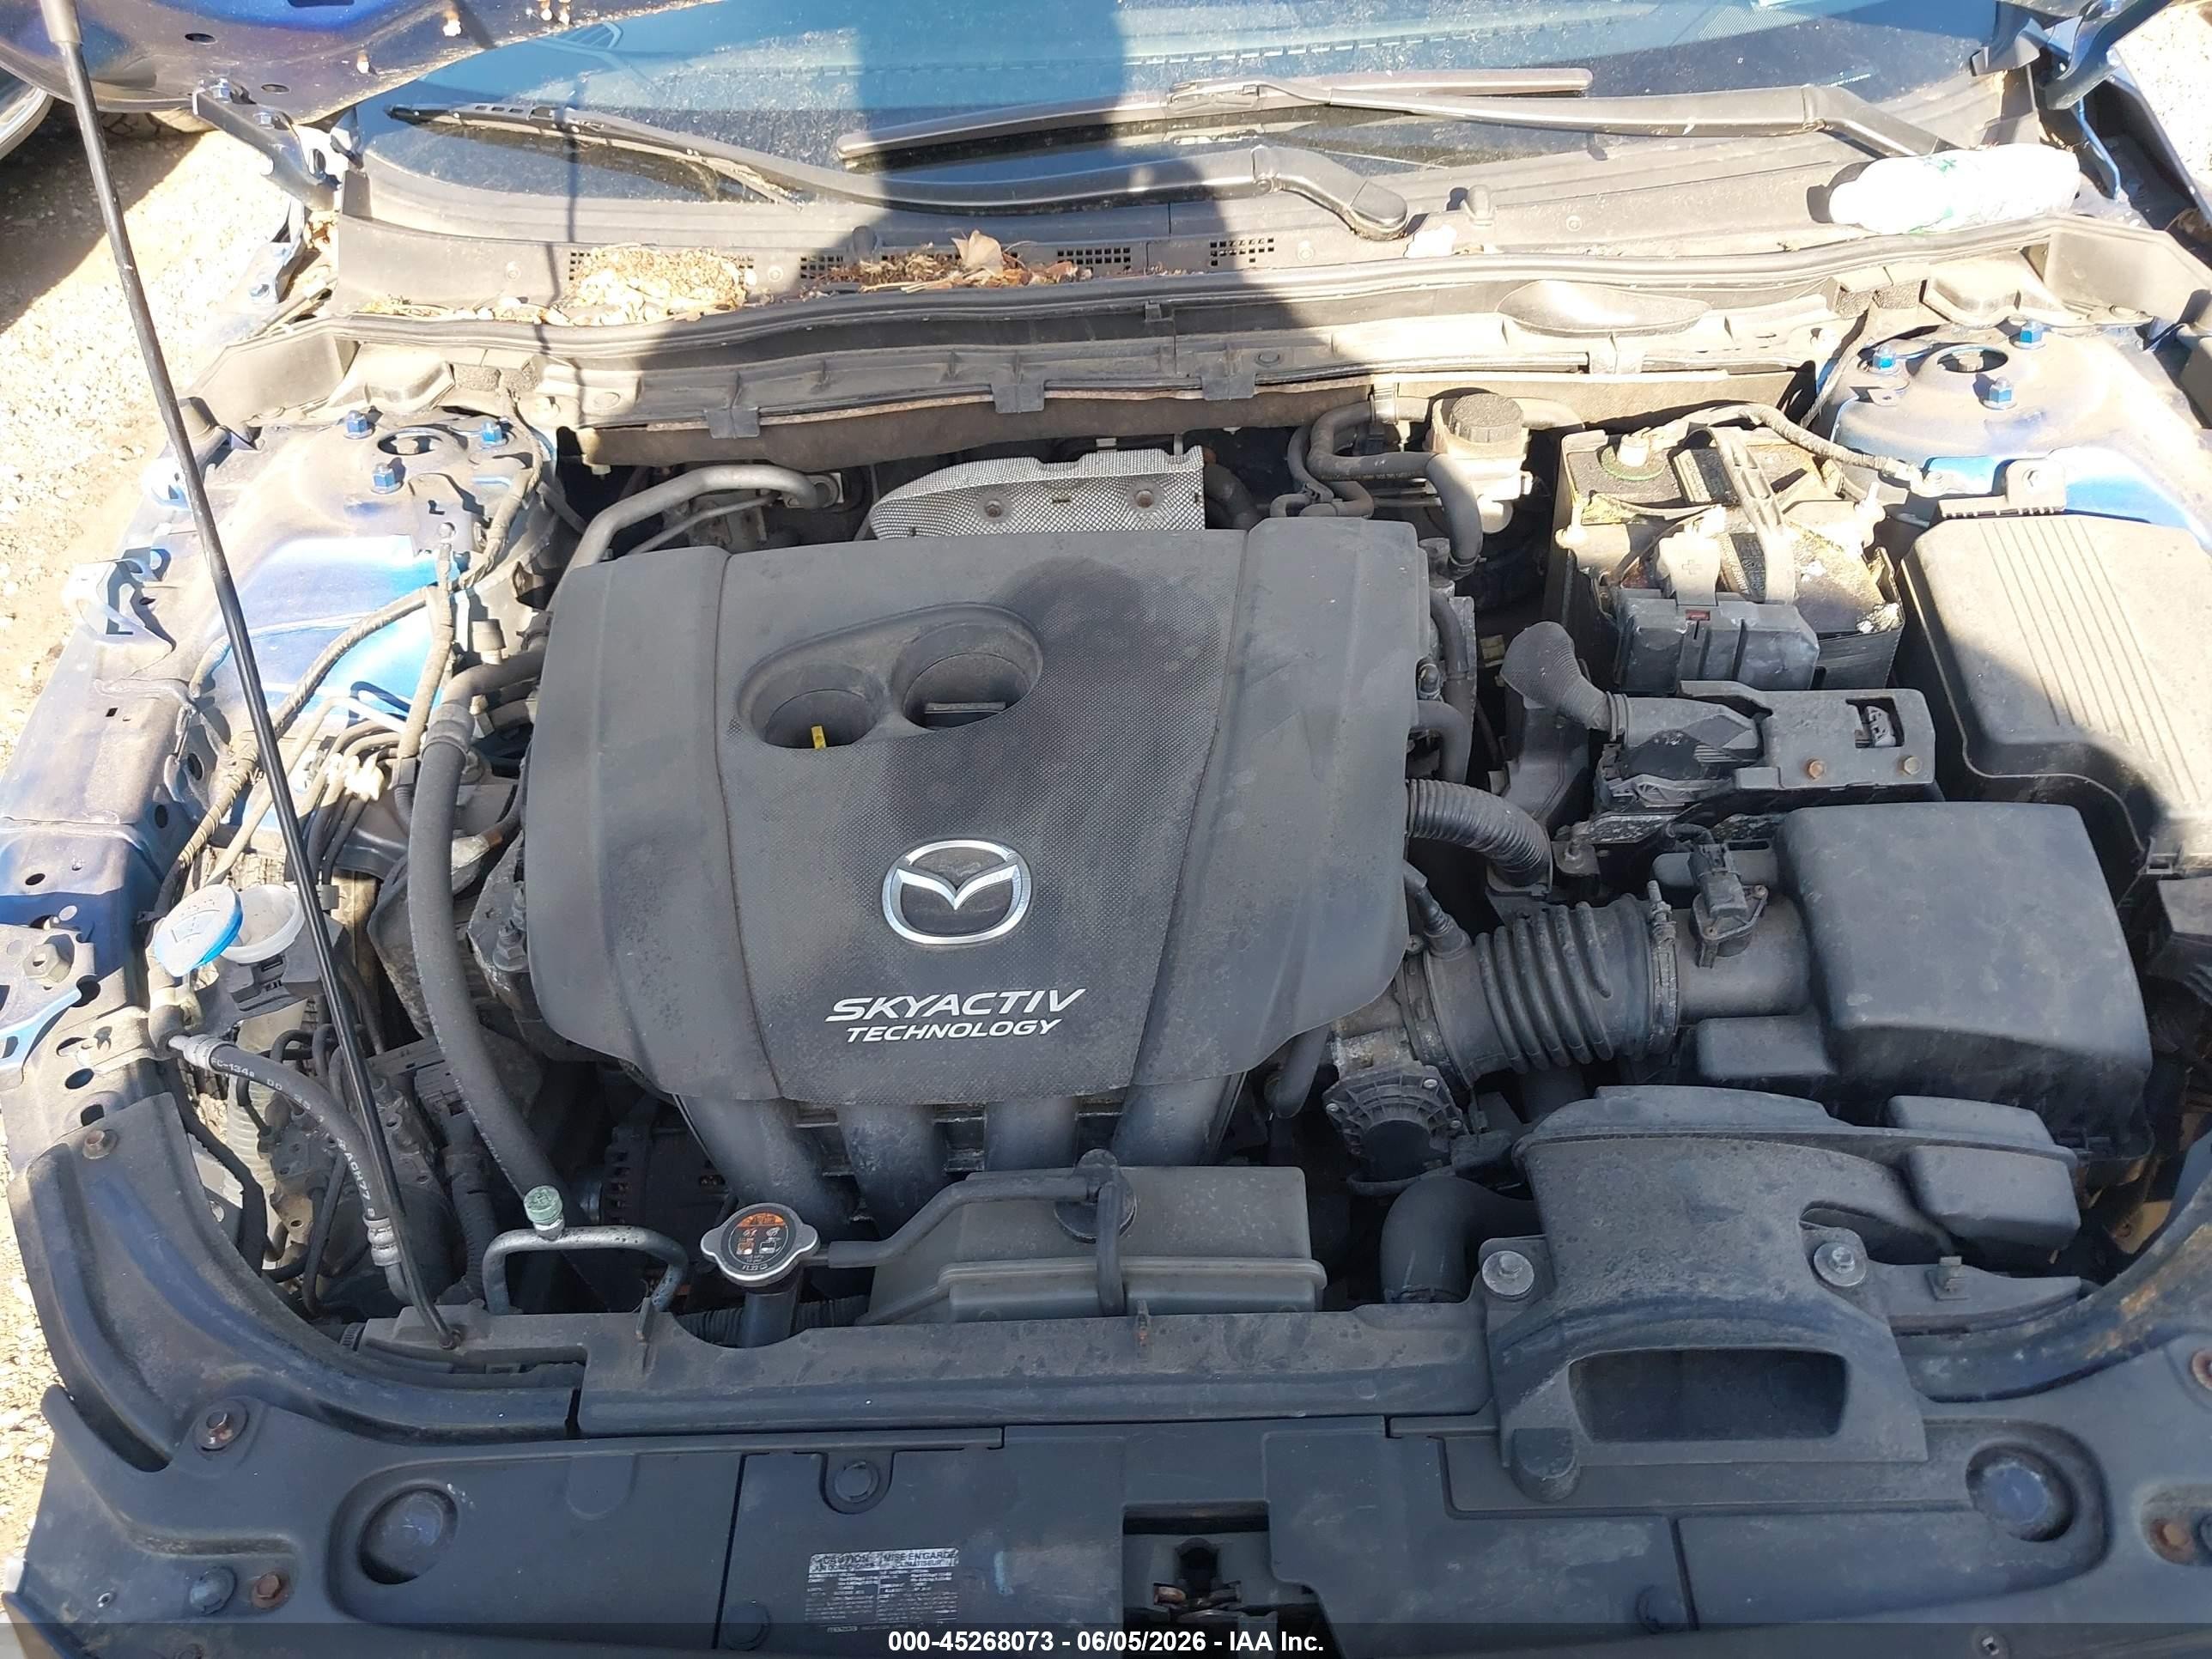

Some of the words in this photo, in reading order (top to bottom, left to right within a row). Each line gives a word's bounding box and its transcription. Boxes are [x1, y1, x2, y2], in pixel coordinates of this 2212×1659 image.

[824, 988, 1086, 1022] SKYACTIV
[846, 1018, 1063, 1042] TECHNOLOGY
[908, 1551, 921, 1560] EN
[923, 1549, 956, 1559] GARDE
